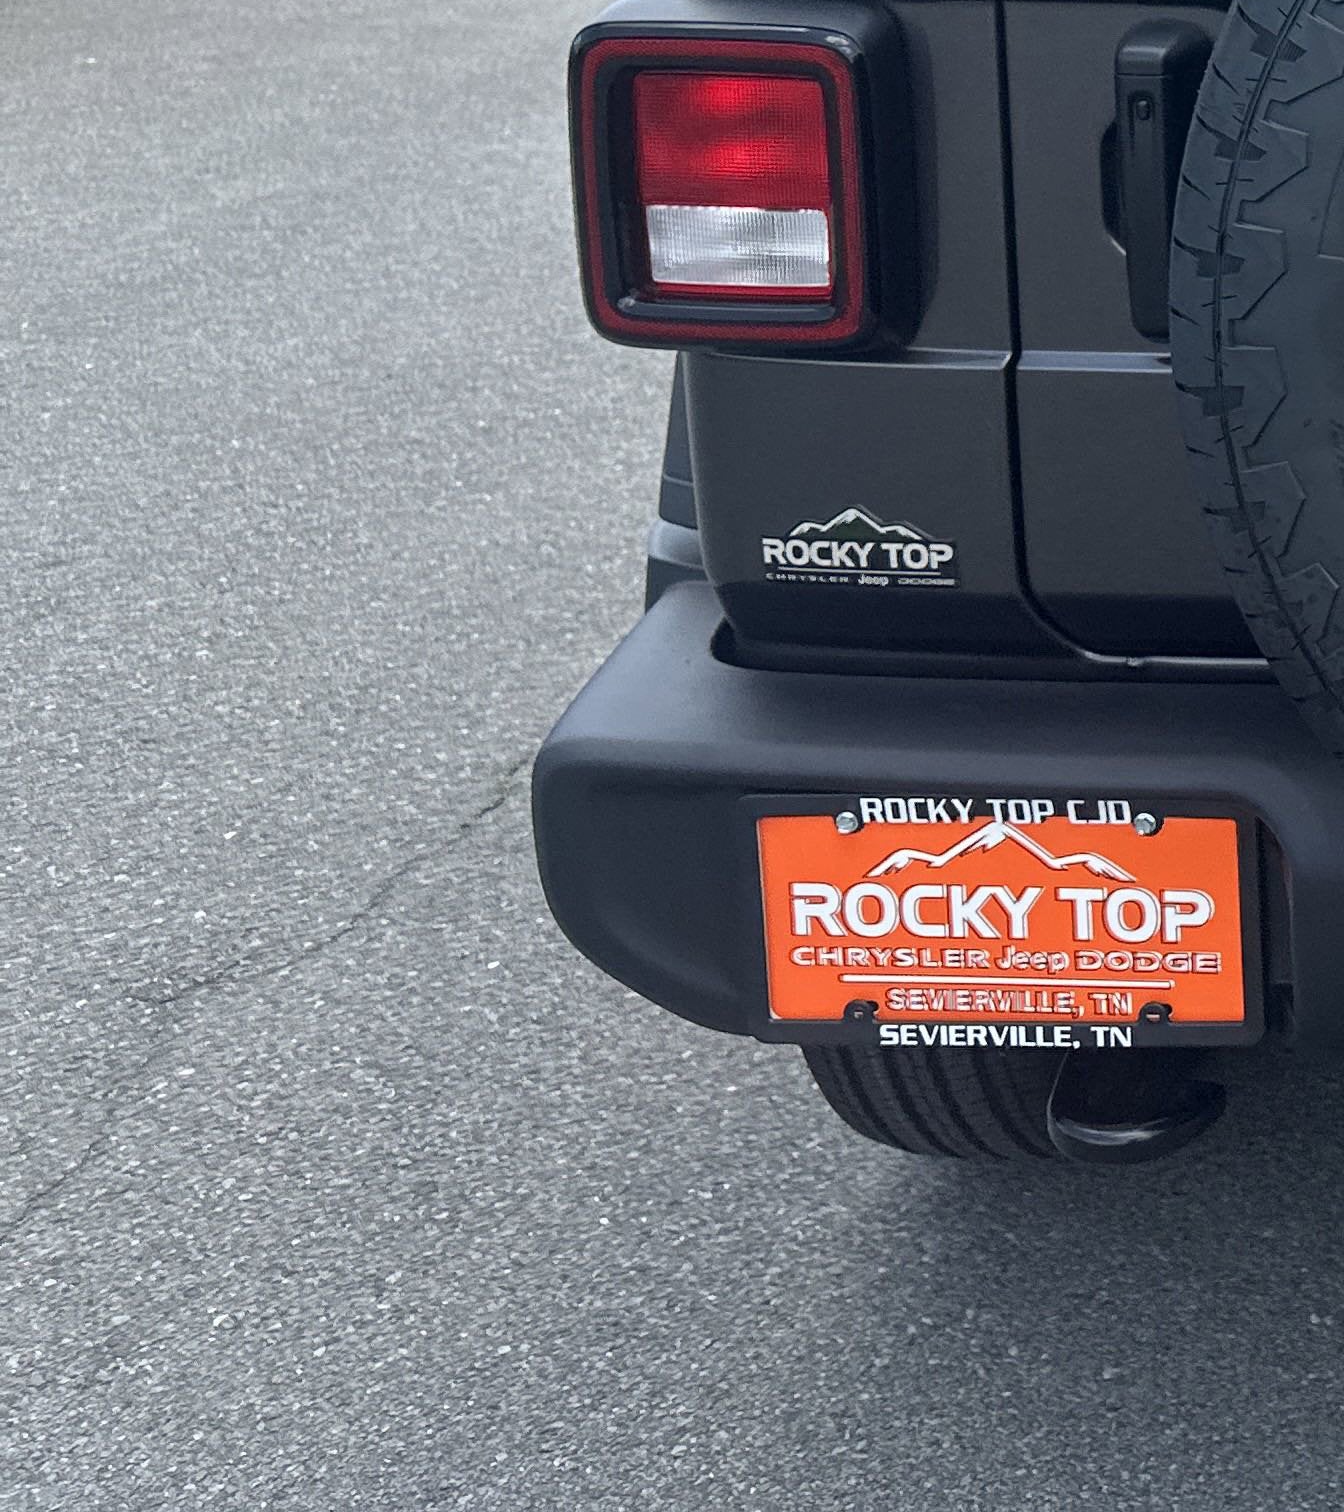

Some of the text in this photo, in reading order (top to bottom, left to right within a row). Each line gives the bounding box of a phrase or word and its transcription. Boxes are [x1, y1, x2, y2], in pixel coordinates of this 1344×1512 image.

[762, 538, 954, 569] ROCKY TOP
[858, 574, 889, 587] Jeep
[859, 797, 1132, 825] ROCKY TOP CJD
[789, 882, 1214, 944] ROCKY TOP
[789, 945, 1223, 975] CHRYSLER Jeep DODGE
[885, 988, 1133, 1018] SEVIERVILLE, TN
[879, 1024, 1133, 1050] SEVIERVILLE, TN
